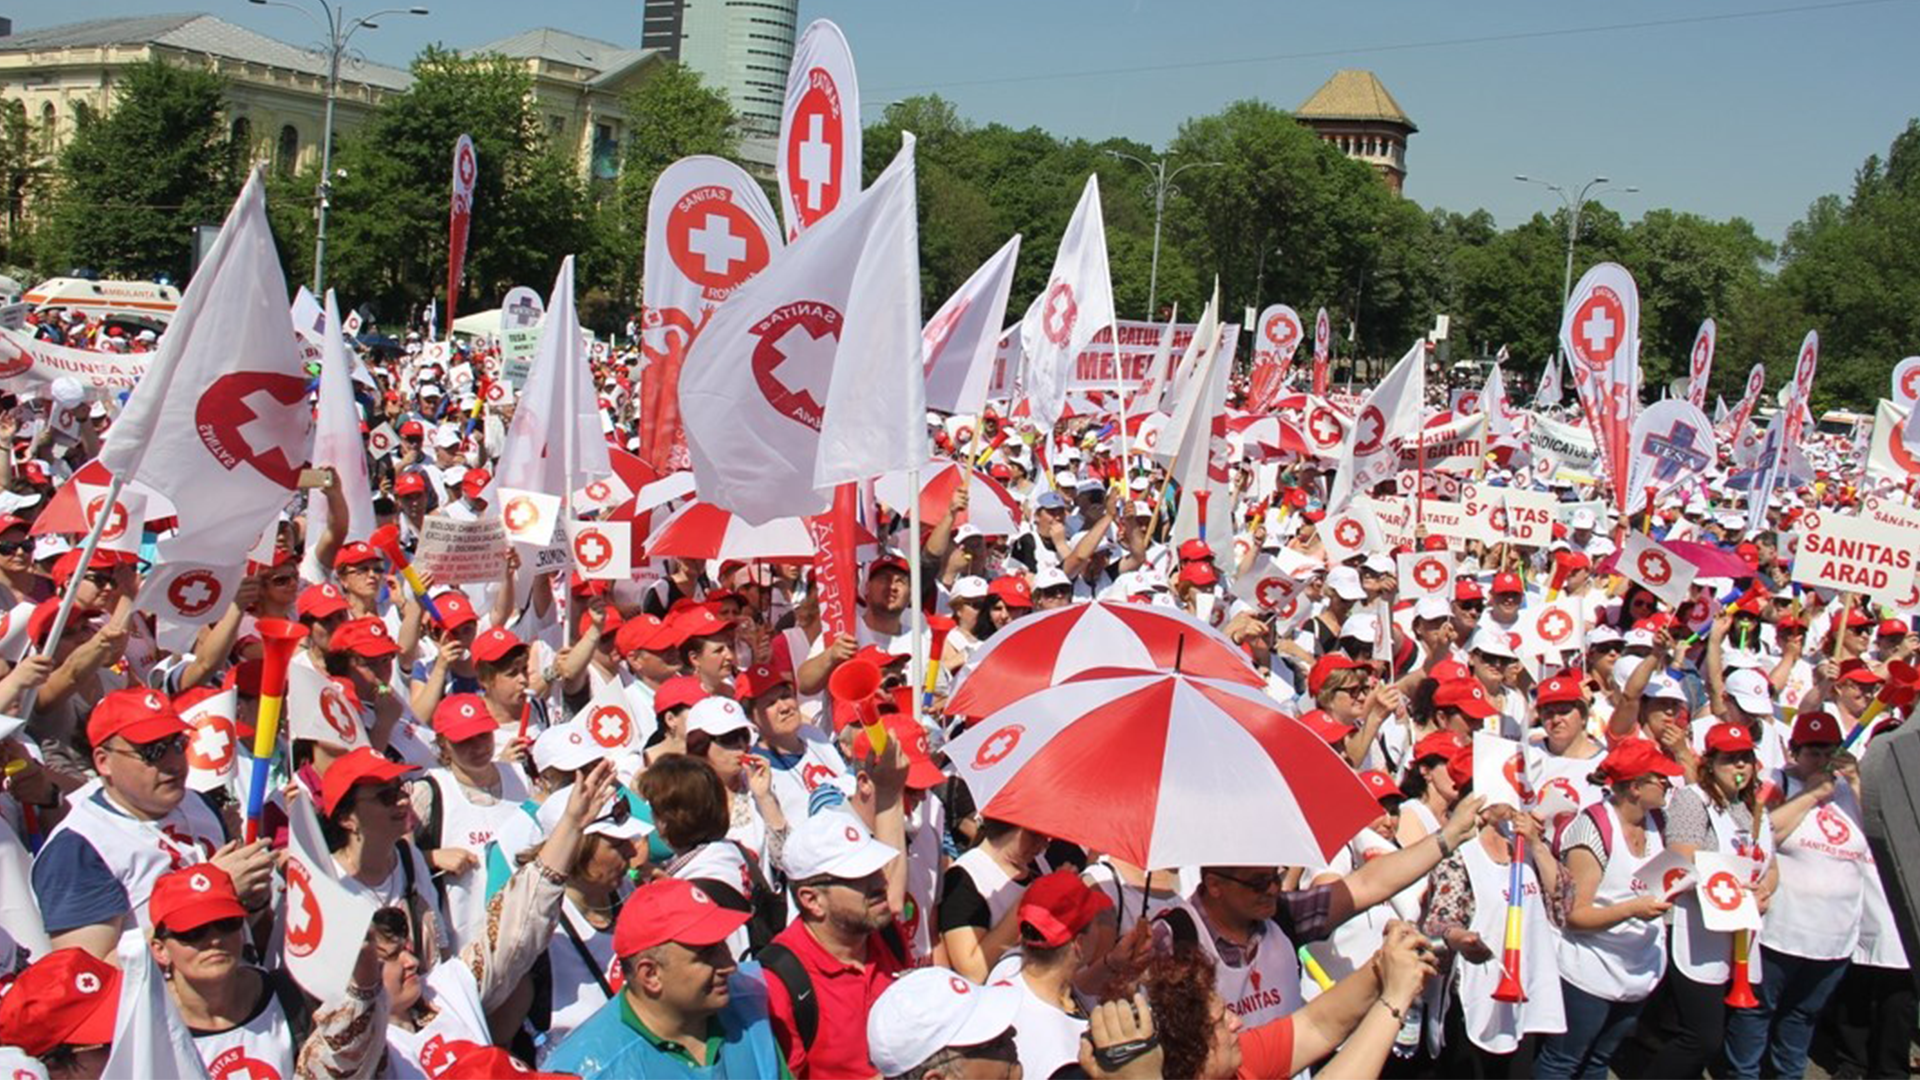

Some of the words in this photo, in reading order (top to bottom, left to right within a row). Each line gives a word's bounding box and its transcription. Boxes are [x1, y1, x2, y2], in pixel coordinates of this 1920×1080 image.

[679, 188, 727, 213] SANITAS
[1653, 442, 1697, 470] TESA
[1804, 533, 1911, 569] SANITAS
[1820, 561, 1888, 589] ARAD
[1226, 988, 1281, 1017] SANITAS
